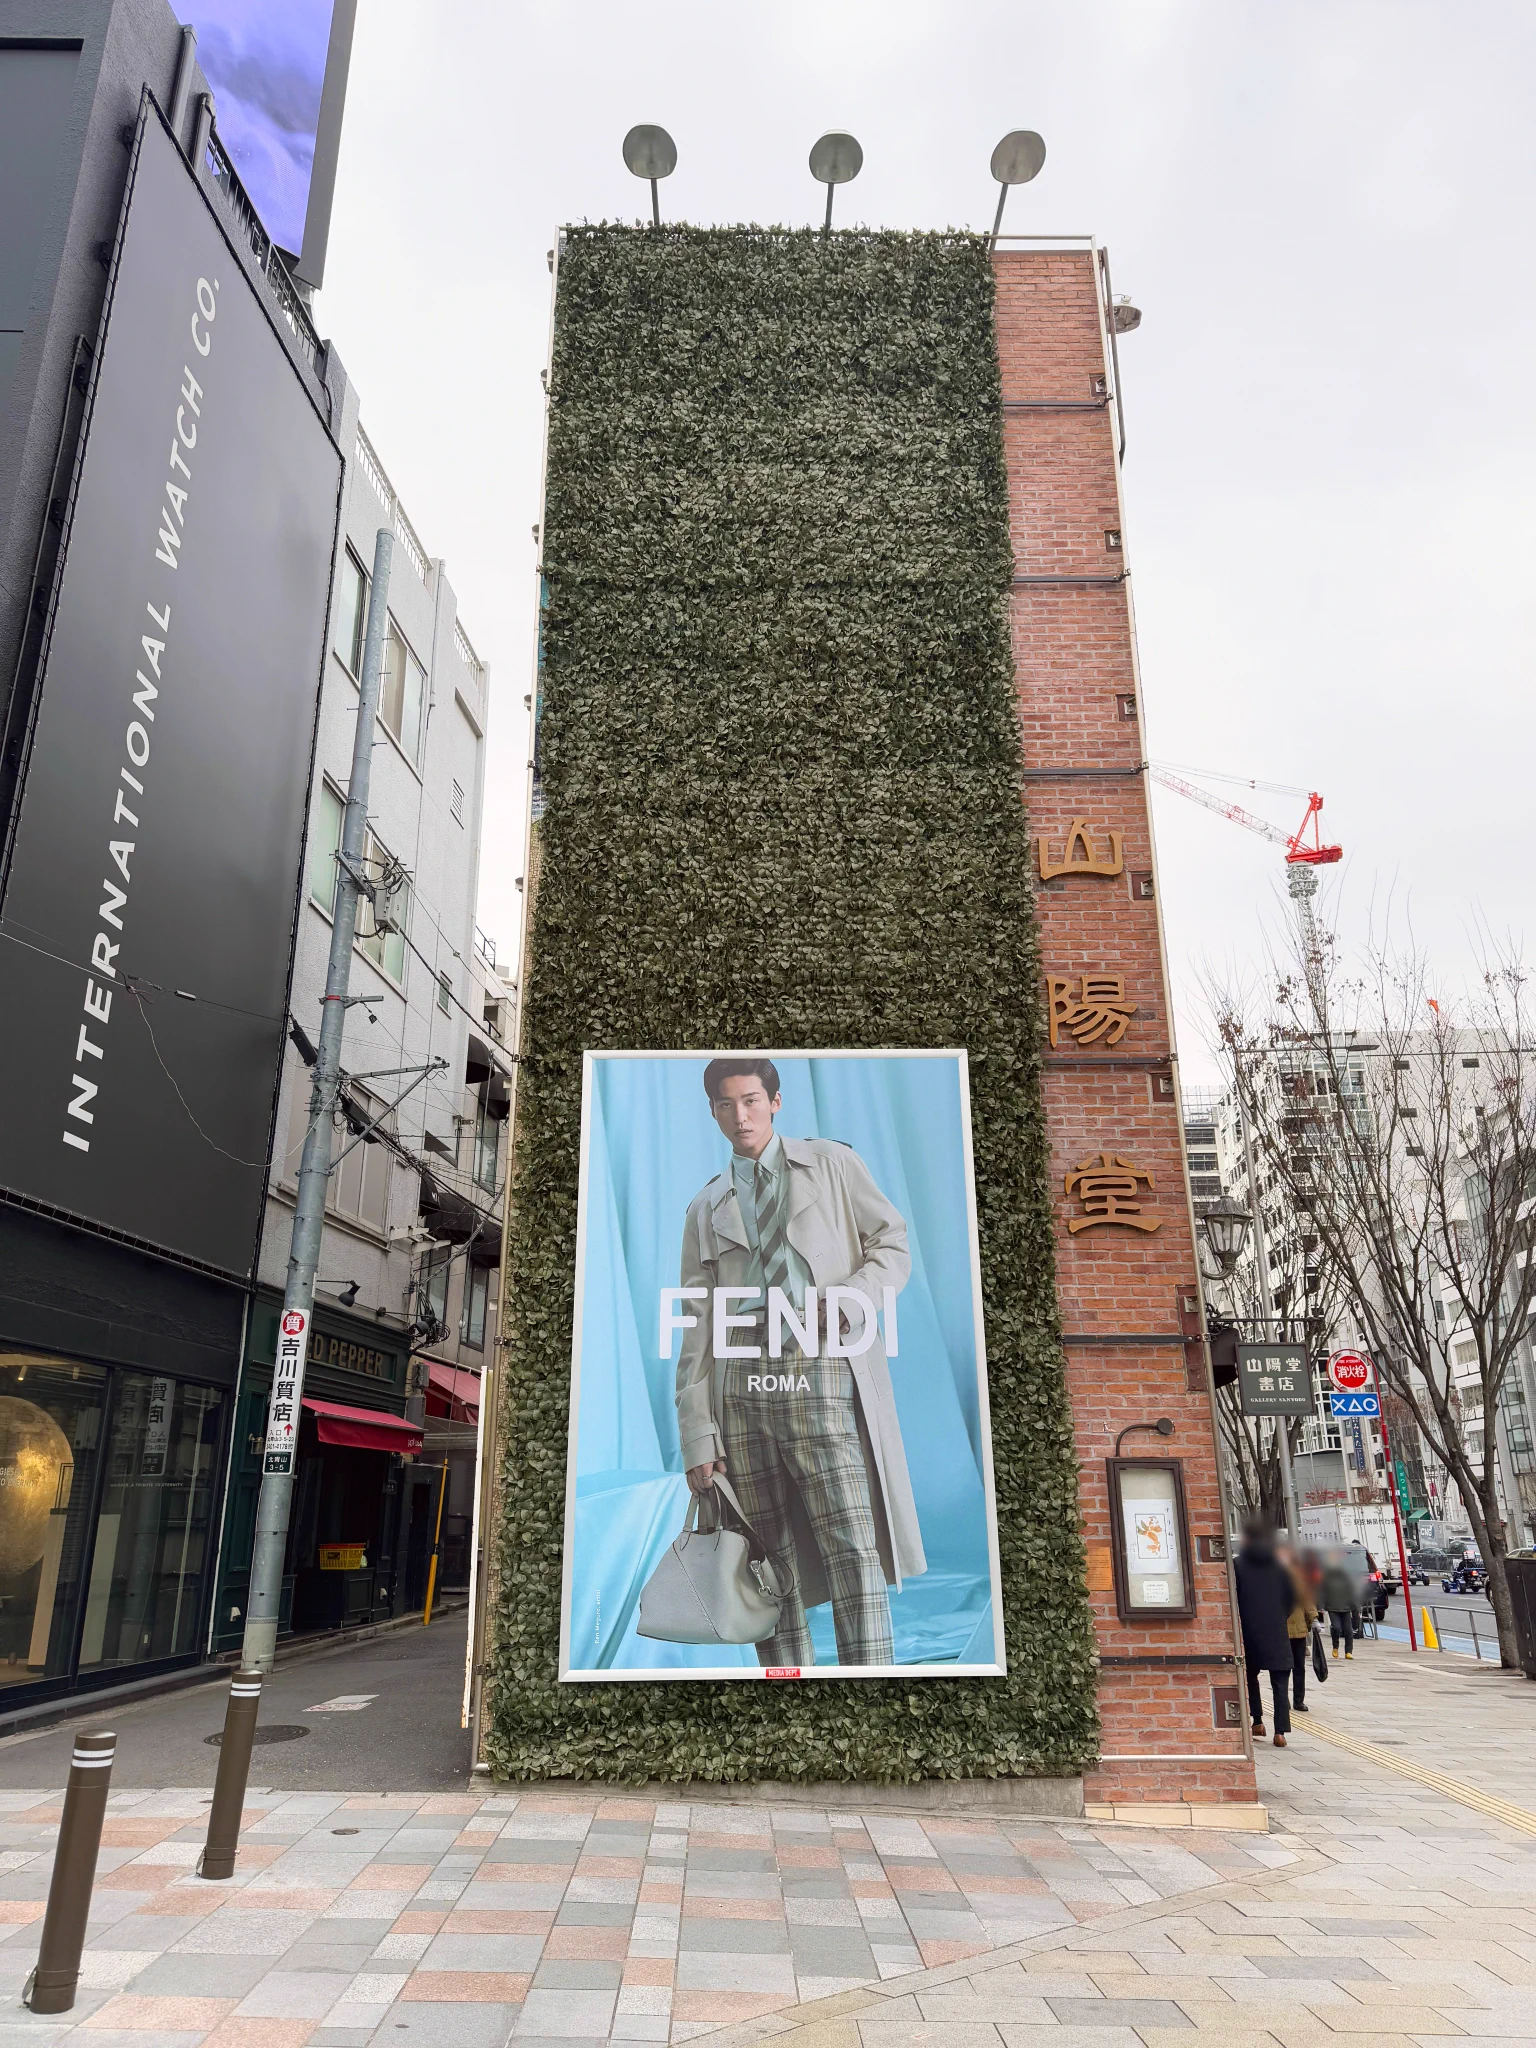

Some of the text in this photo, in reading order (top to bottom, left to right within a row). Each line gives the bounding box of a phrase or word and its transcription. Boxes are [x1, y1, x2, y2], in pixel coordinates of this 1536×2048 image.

[63, 277, 220, 1152] INTERNATIONAL WATCH CO.
[1038, 816, 1163, 1235] 山陽堂
[659, 1286, 898, 1359] FENDI
[328, 1339, 384, 1376] PEPPER
[1246, 1357, 1302, 1372] 山陽堂
[1337, 1365, 1366, 1378] 消火栓
[747, 1374, 811, 1392] ROMA
[1258, 1376, 1295, 1391] 書店
[768, 1669, 799, 1677] MEDIA DEPT.
